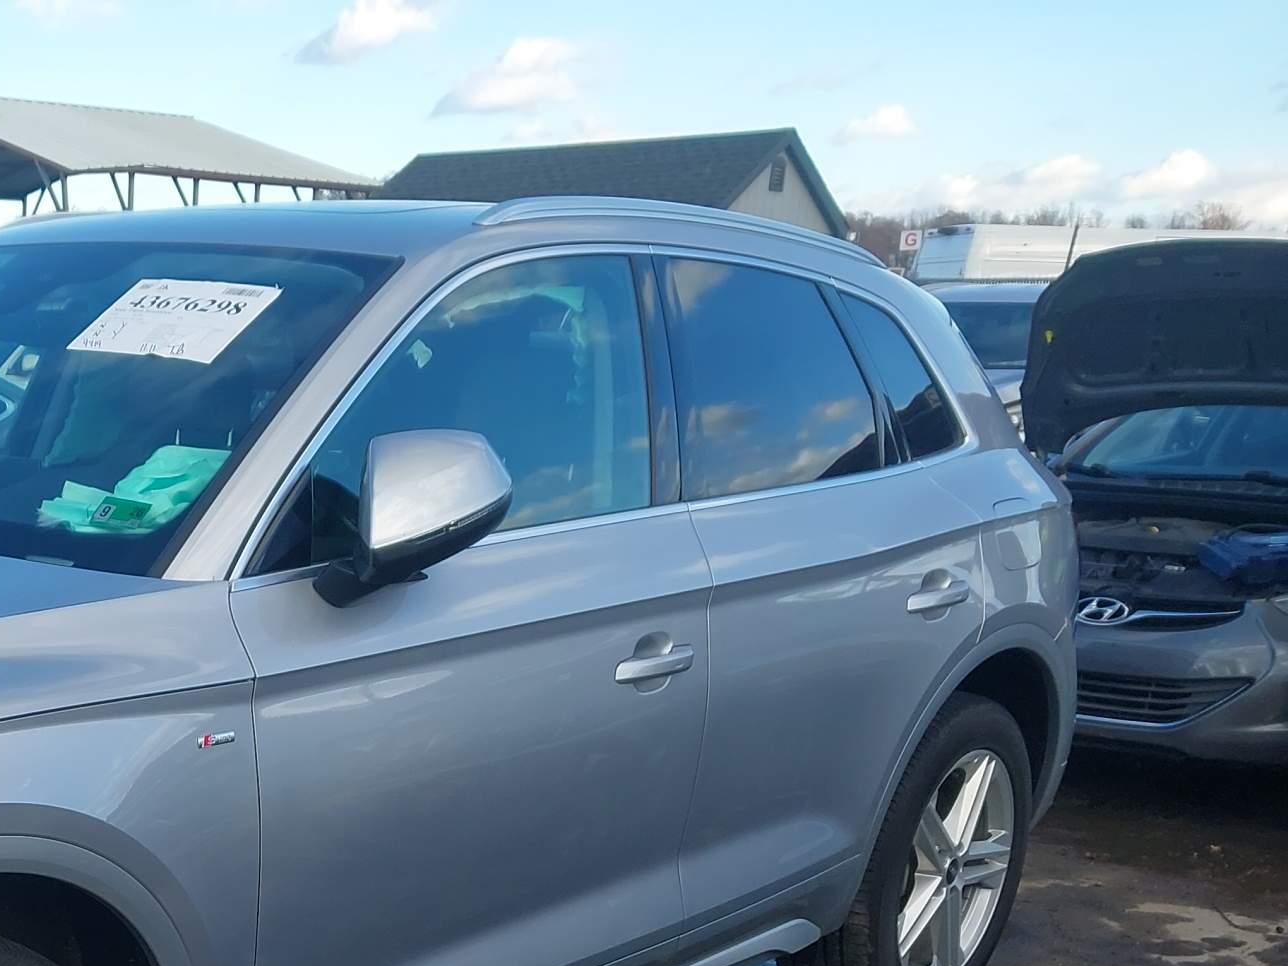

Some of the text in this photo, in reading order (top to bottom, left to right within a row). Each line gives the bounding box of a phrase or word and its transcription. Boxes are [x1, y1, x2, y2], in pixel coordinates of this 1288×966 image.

[905, 232, 917, 247] G
[129, 294, 248, 316] 43676298
[99, 505, 112, 518] 9
